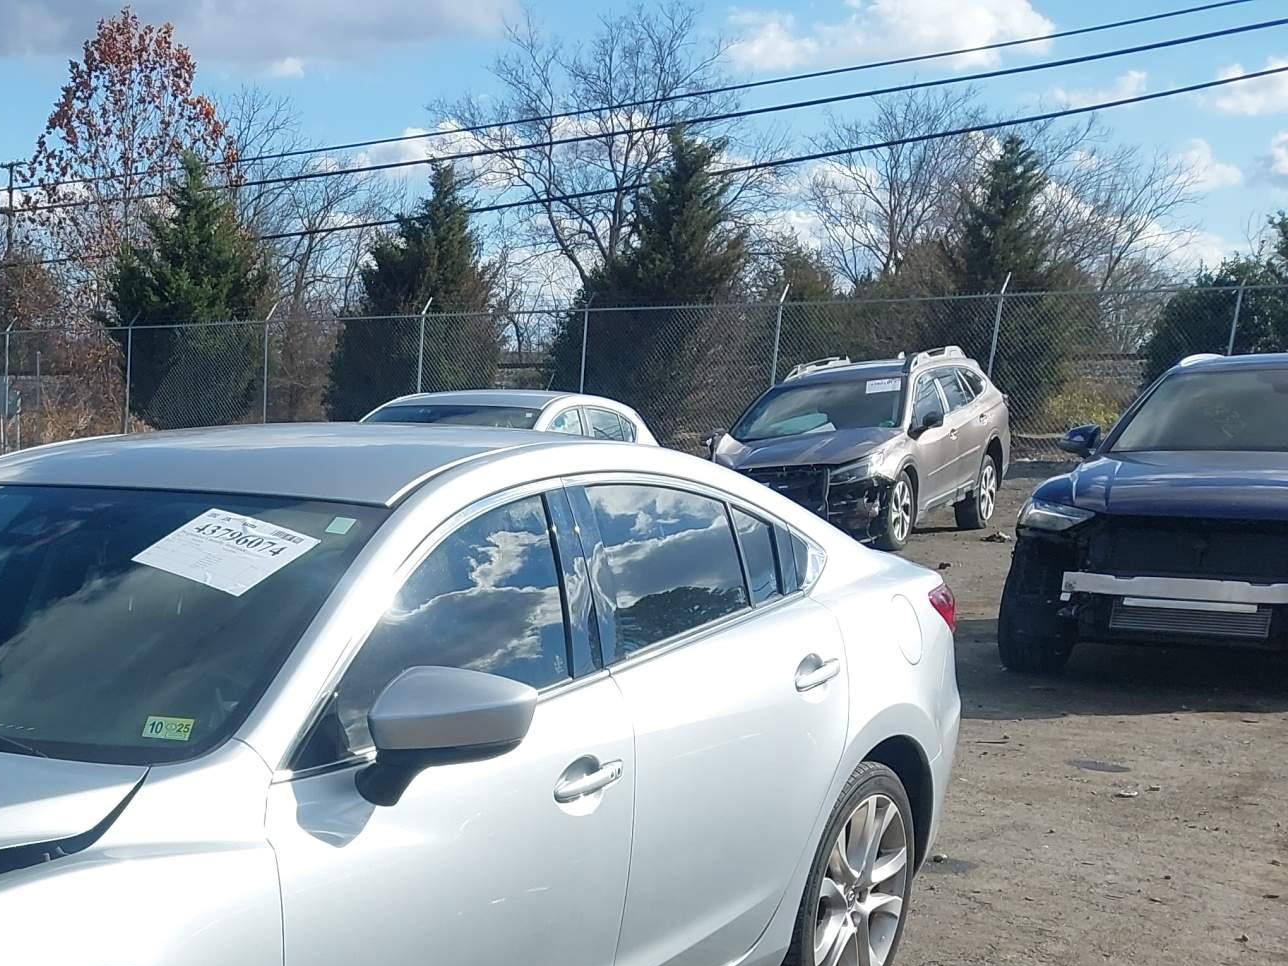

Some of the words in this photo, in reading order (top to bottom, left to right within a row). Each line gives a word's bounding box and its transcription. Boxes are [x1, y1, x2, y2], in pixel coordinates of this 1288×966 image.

[194, 523, 288, 557] 43796074
[149, 721, 164, 734] 10
[176, 723, 192, 734] 25
